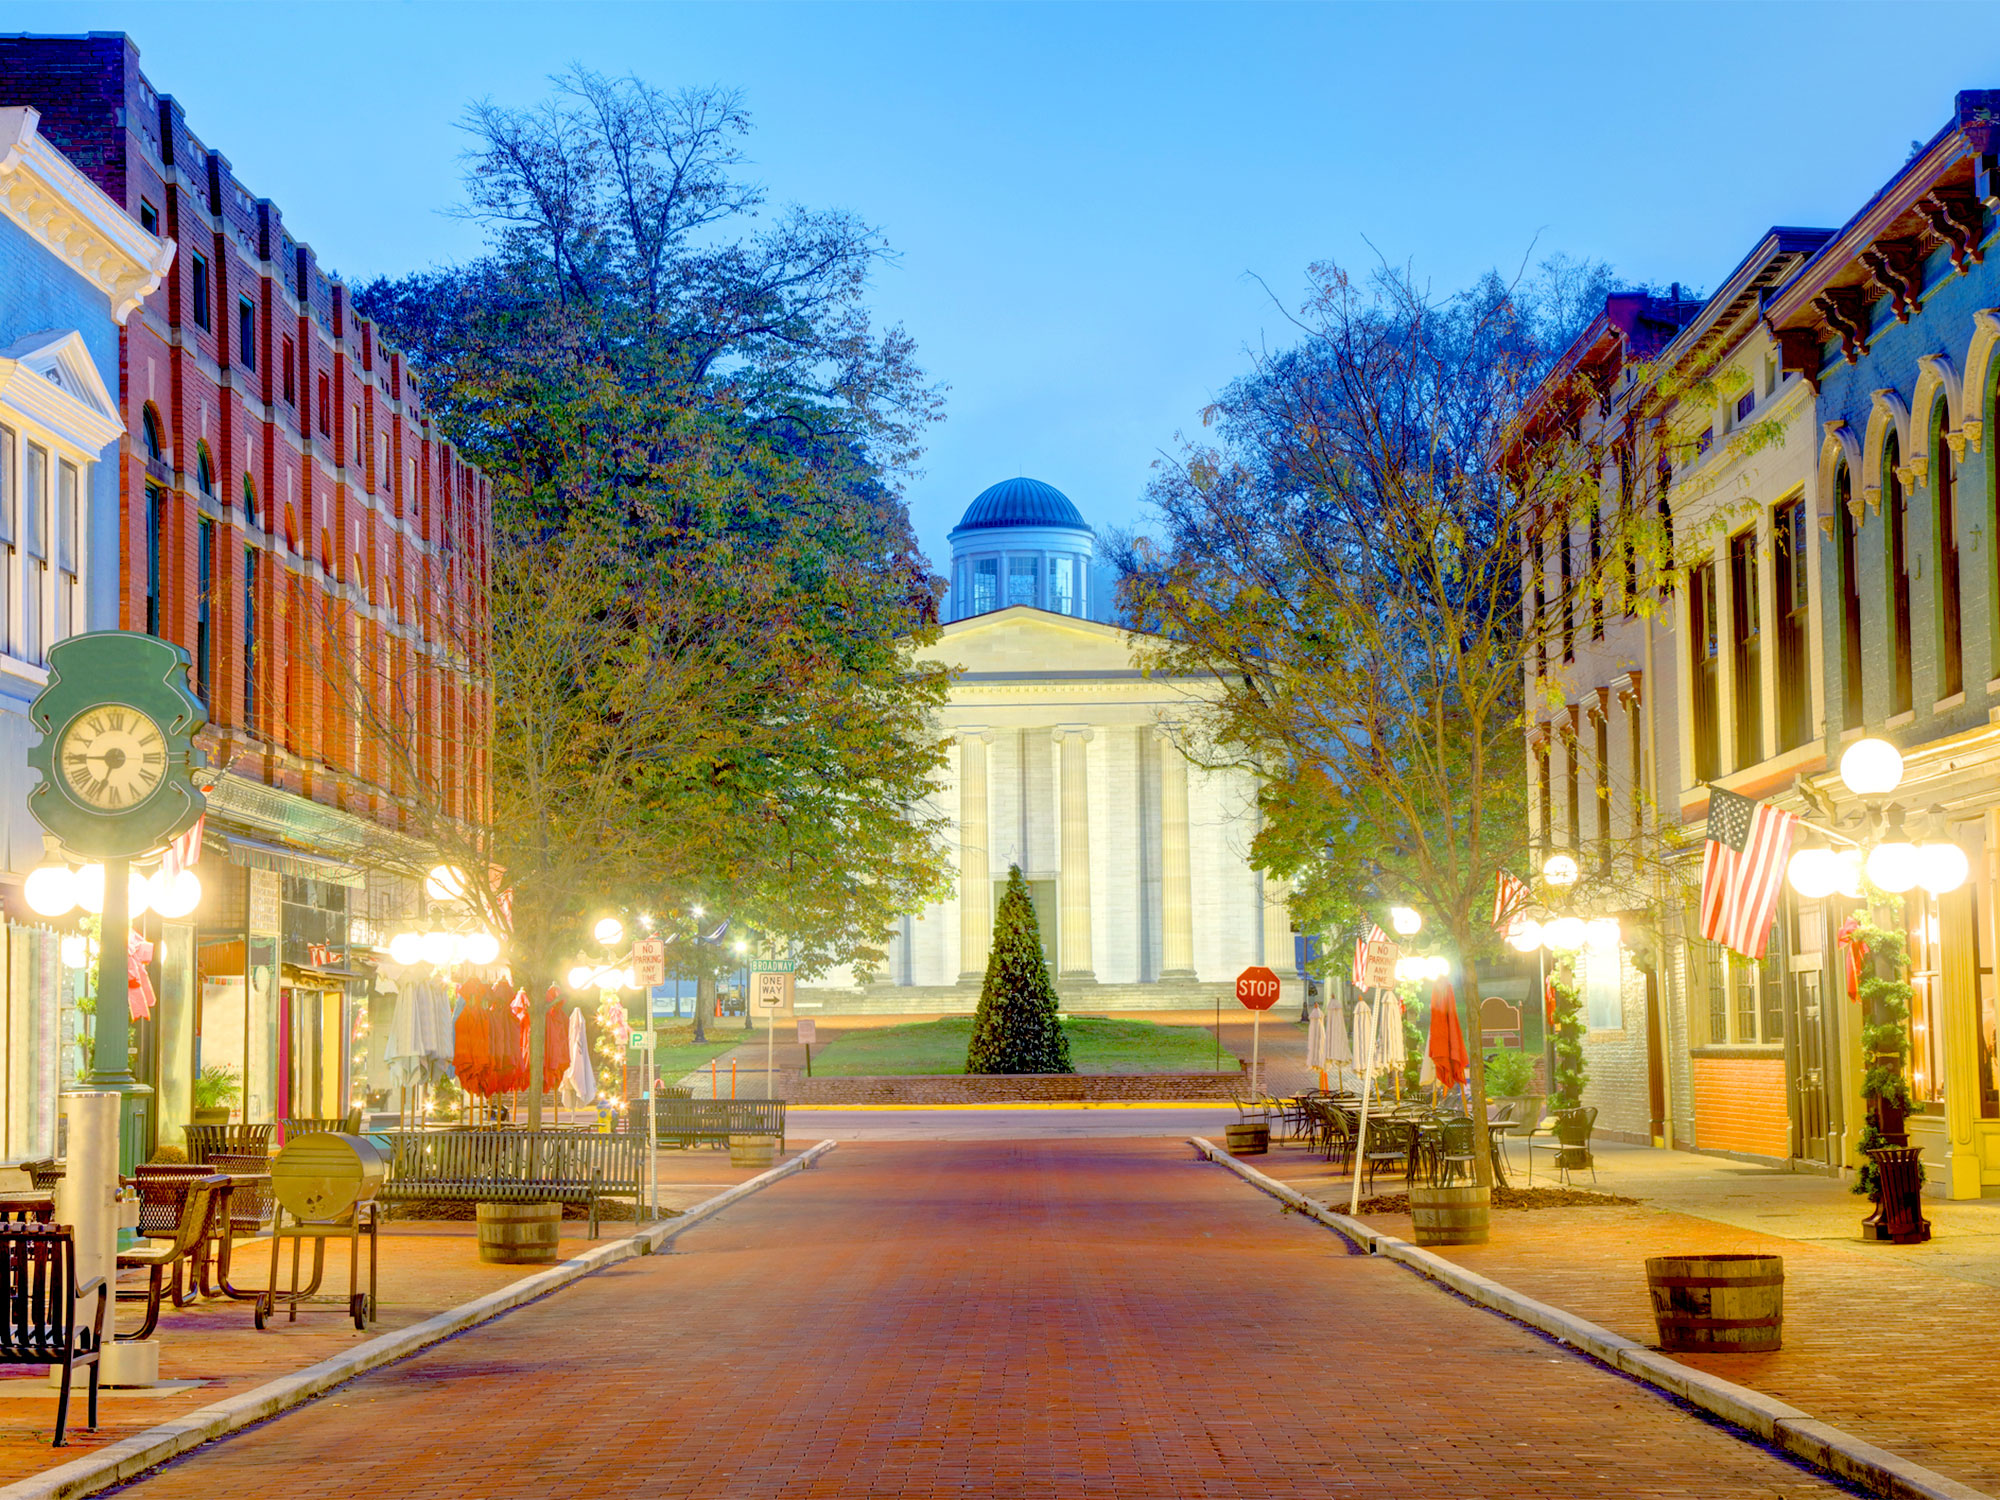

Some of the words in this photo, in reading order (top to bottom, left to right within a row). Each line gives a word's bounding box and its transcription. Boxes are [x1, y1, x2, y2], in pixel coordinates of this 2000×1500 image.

[87, 717, 106, 737] XI
[107, 713, 124, 731] XII
[127, 718, 140, 735] I
[72, 733, 93, 748] X
[138, 733, 155, 747] II
[143, 752, 161, 764] III
[71, 767, 92, 790] VIII
[109, 786, 121, 804] VI
[128, 782, 142, 800] V
[643, 945, 653, 954] NO
[1377, 946, 1388, 955] NO
[635, 955, 662, 964] PARKING
[753, 960, 793, 971] BROADWAY
[1374, 966, 1387, 974] ANY
[642, 974, 656, 982] TIME
[763, 977, 782, 985] ONE
[762, 986, 782, 994] WAY
[1239, 980, 1278, 997] STOP
[632, 1034, 643, 1046] P
